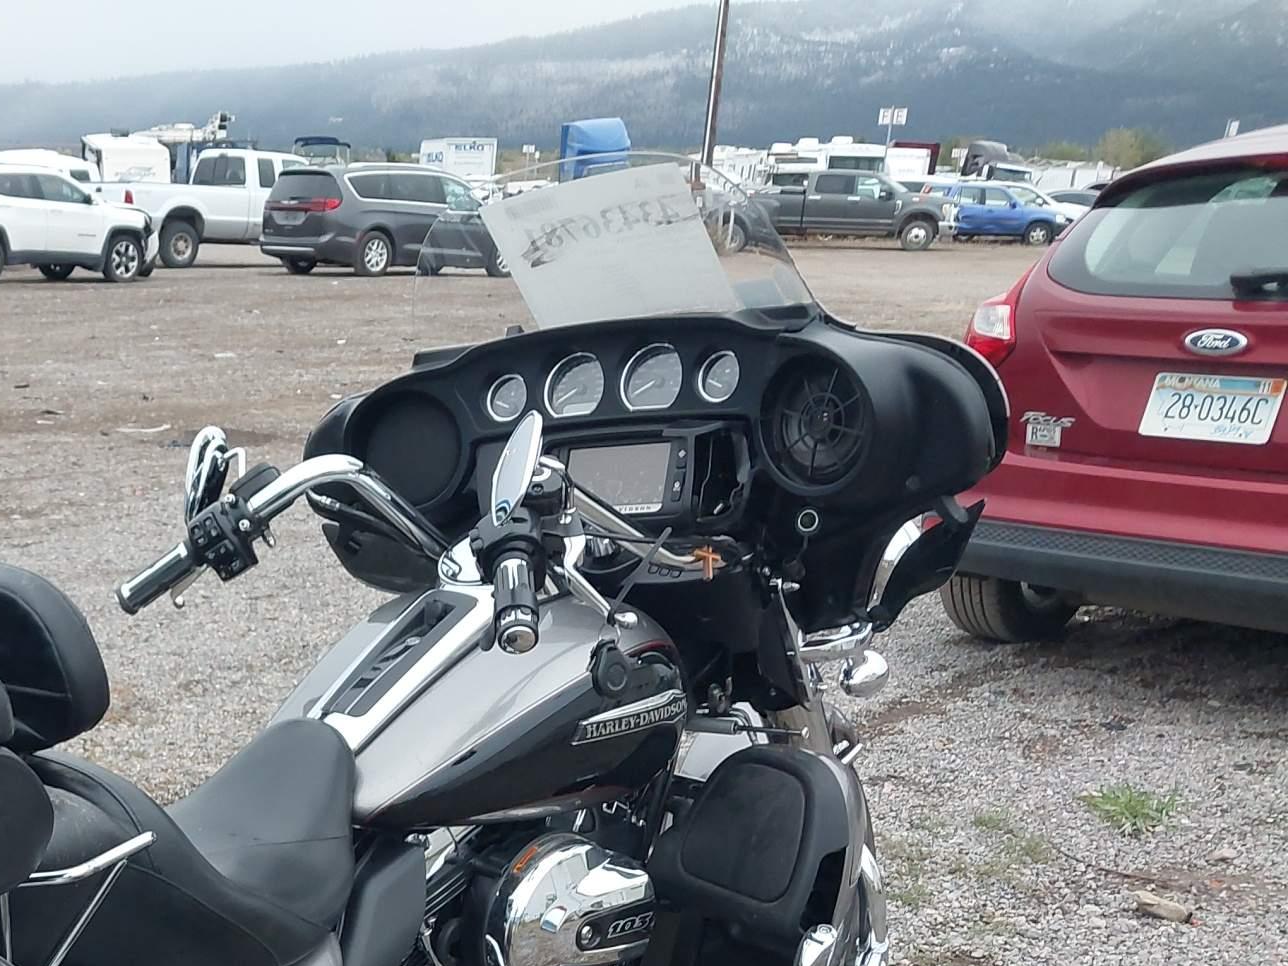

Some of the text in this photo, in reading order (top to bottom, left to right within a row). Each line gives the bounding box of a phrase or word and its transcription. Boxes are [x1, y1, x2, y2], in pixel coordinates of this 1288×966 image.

[1197, 334, 1232, 349] Ford
[585, 698, 688, 739] HARLEY-DAVIDSON
[607, 911, 653, 938] 103
